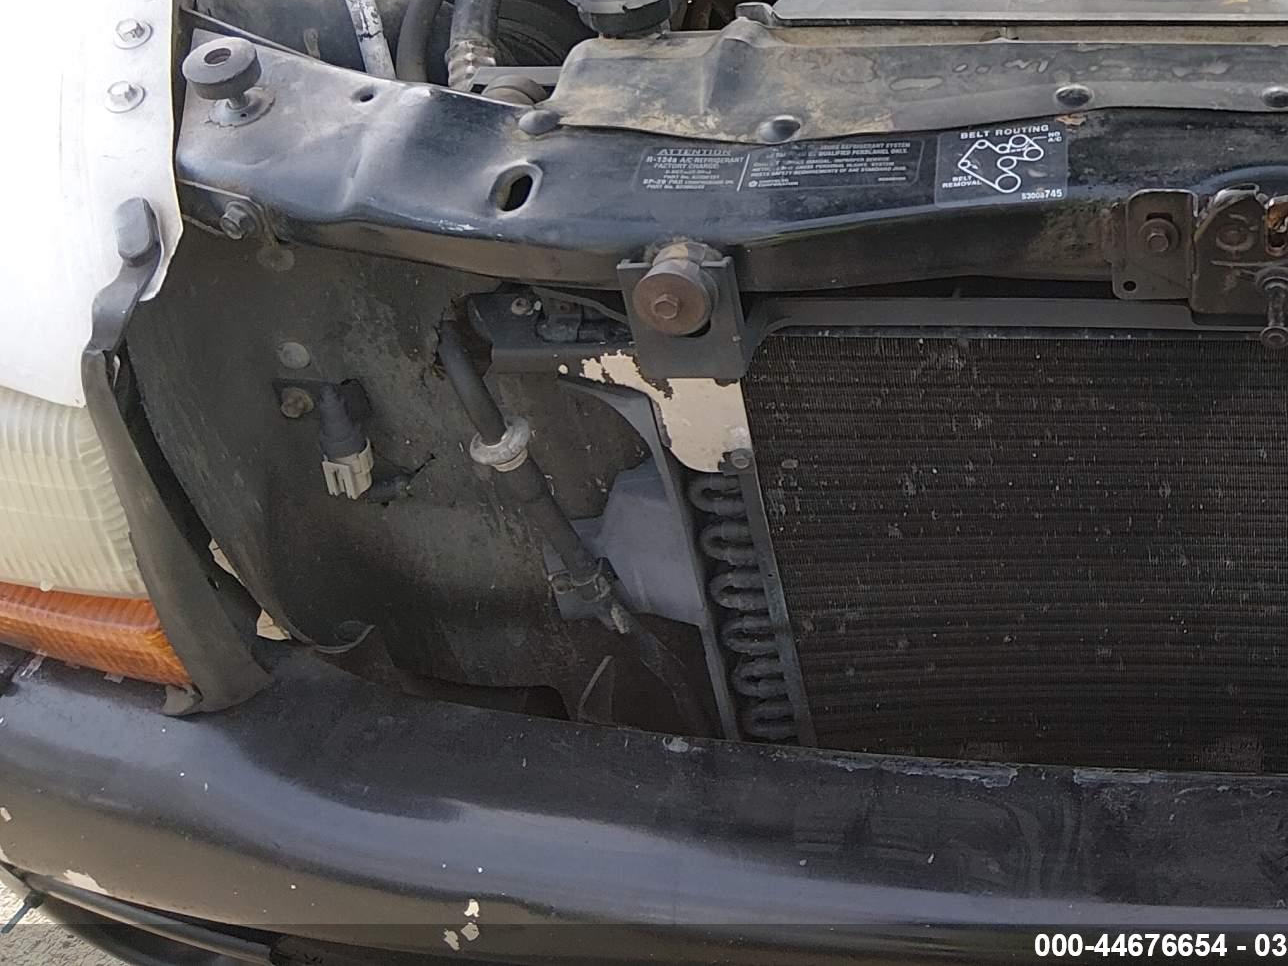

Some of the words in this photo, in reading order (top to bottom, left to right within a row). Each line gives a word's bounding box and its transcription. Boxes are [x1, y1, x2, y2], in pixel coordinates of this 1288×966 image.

[960, 130, 991, 140] BELT
[994, 124, 1050, 137] ROUTING
[656, 148, 732, 156] ATTENTION
[951, 175, 973, 183] BELT
